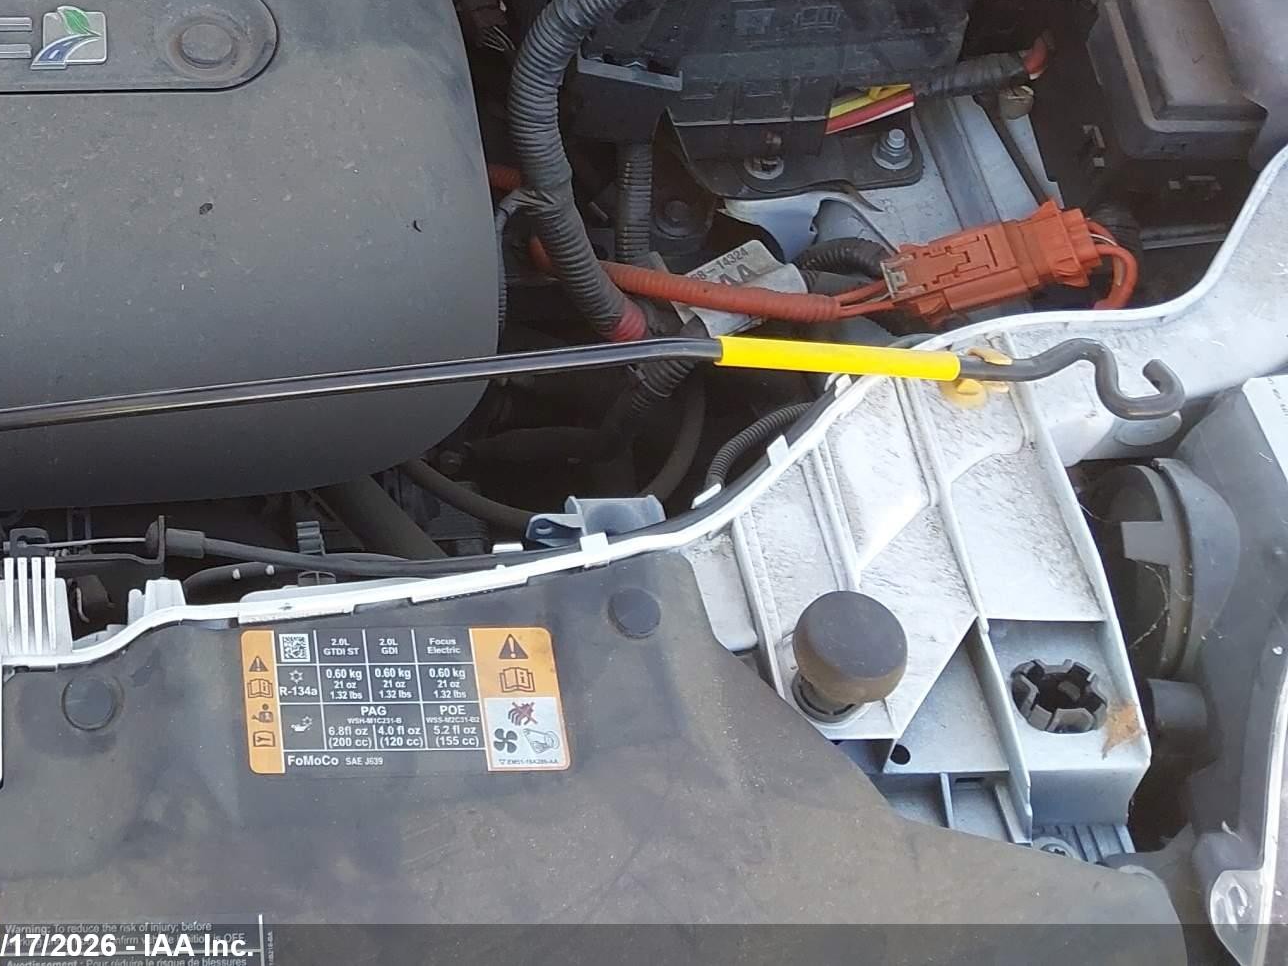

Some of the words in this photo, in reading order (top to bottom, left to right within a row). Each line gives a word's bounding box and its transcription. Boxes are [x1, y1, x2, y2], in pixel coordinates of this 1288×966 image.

[330, 638, 350, 646] 2.0L
[379, 638, 398, 646] 2.0L
[429, 637, 456, 646] Focus
[323, 647, 345, 656] GTDI
[347, 647, 360, 656] ST
[381, 647, 398, 655] GDI
[428, 646, 461, 654] Electric
[326, 668, 346, 679] 0.60
[348, 668, 362, 681] kg
[375, 668, 395, 679] 0.60
[397, 668, 411, 681] kg
[429, 668, 449, 679] 0.60
[451, 668, 465, 681] kg
[334, 680, 343, 689] 21
[382, 680, 392, 689] 21
[437, 680, 447, 689] 21
[279, 686, 318, 697] R-134a
[330, 690, 347, 699] 1.32
[349, 690, 363, 699] lbs
[379, 690, 395, 699] 1.32
[397, 690, 412, 699] lbs
[434, 690, 450, 699] 1.32
[452, 690, 466, 699] lbs
[360, 706, 387, 716] PAG
[439, 705, 465, 715] POE
[353, 728, 368, 736] oz
[378, 726, 394, 736] 4.0
[397, 726, 405, 736] fl
[407, 728, 422, 736] oz
[434, 726, 450, 736] 5.2
[452, 726, 460, 736] fl
[462, 727, 477, 736] oz
[328, 737, 351, 749] (200
[353, 737, 372, 749] cc)
[380, 737, 402, 748] (120
[404, 737, 423, 748] cc)
[436, 736, 458, 748] (155
[460, 736, 480, 748] cc)
[288, 755, 339, 766] FoMoCo
[345, 756, 362, 766] SAE
[5, 924, 51, 936] Warning:
[54, 923, 65, 933] To
[67, 923, 100, 933] reduce
[102, 923, 117, 932] the
[119, 922, 136, 932] risk
[138, 922, 149, 931] of
[181, 921, 212, 931] before
